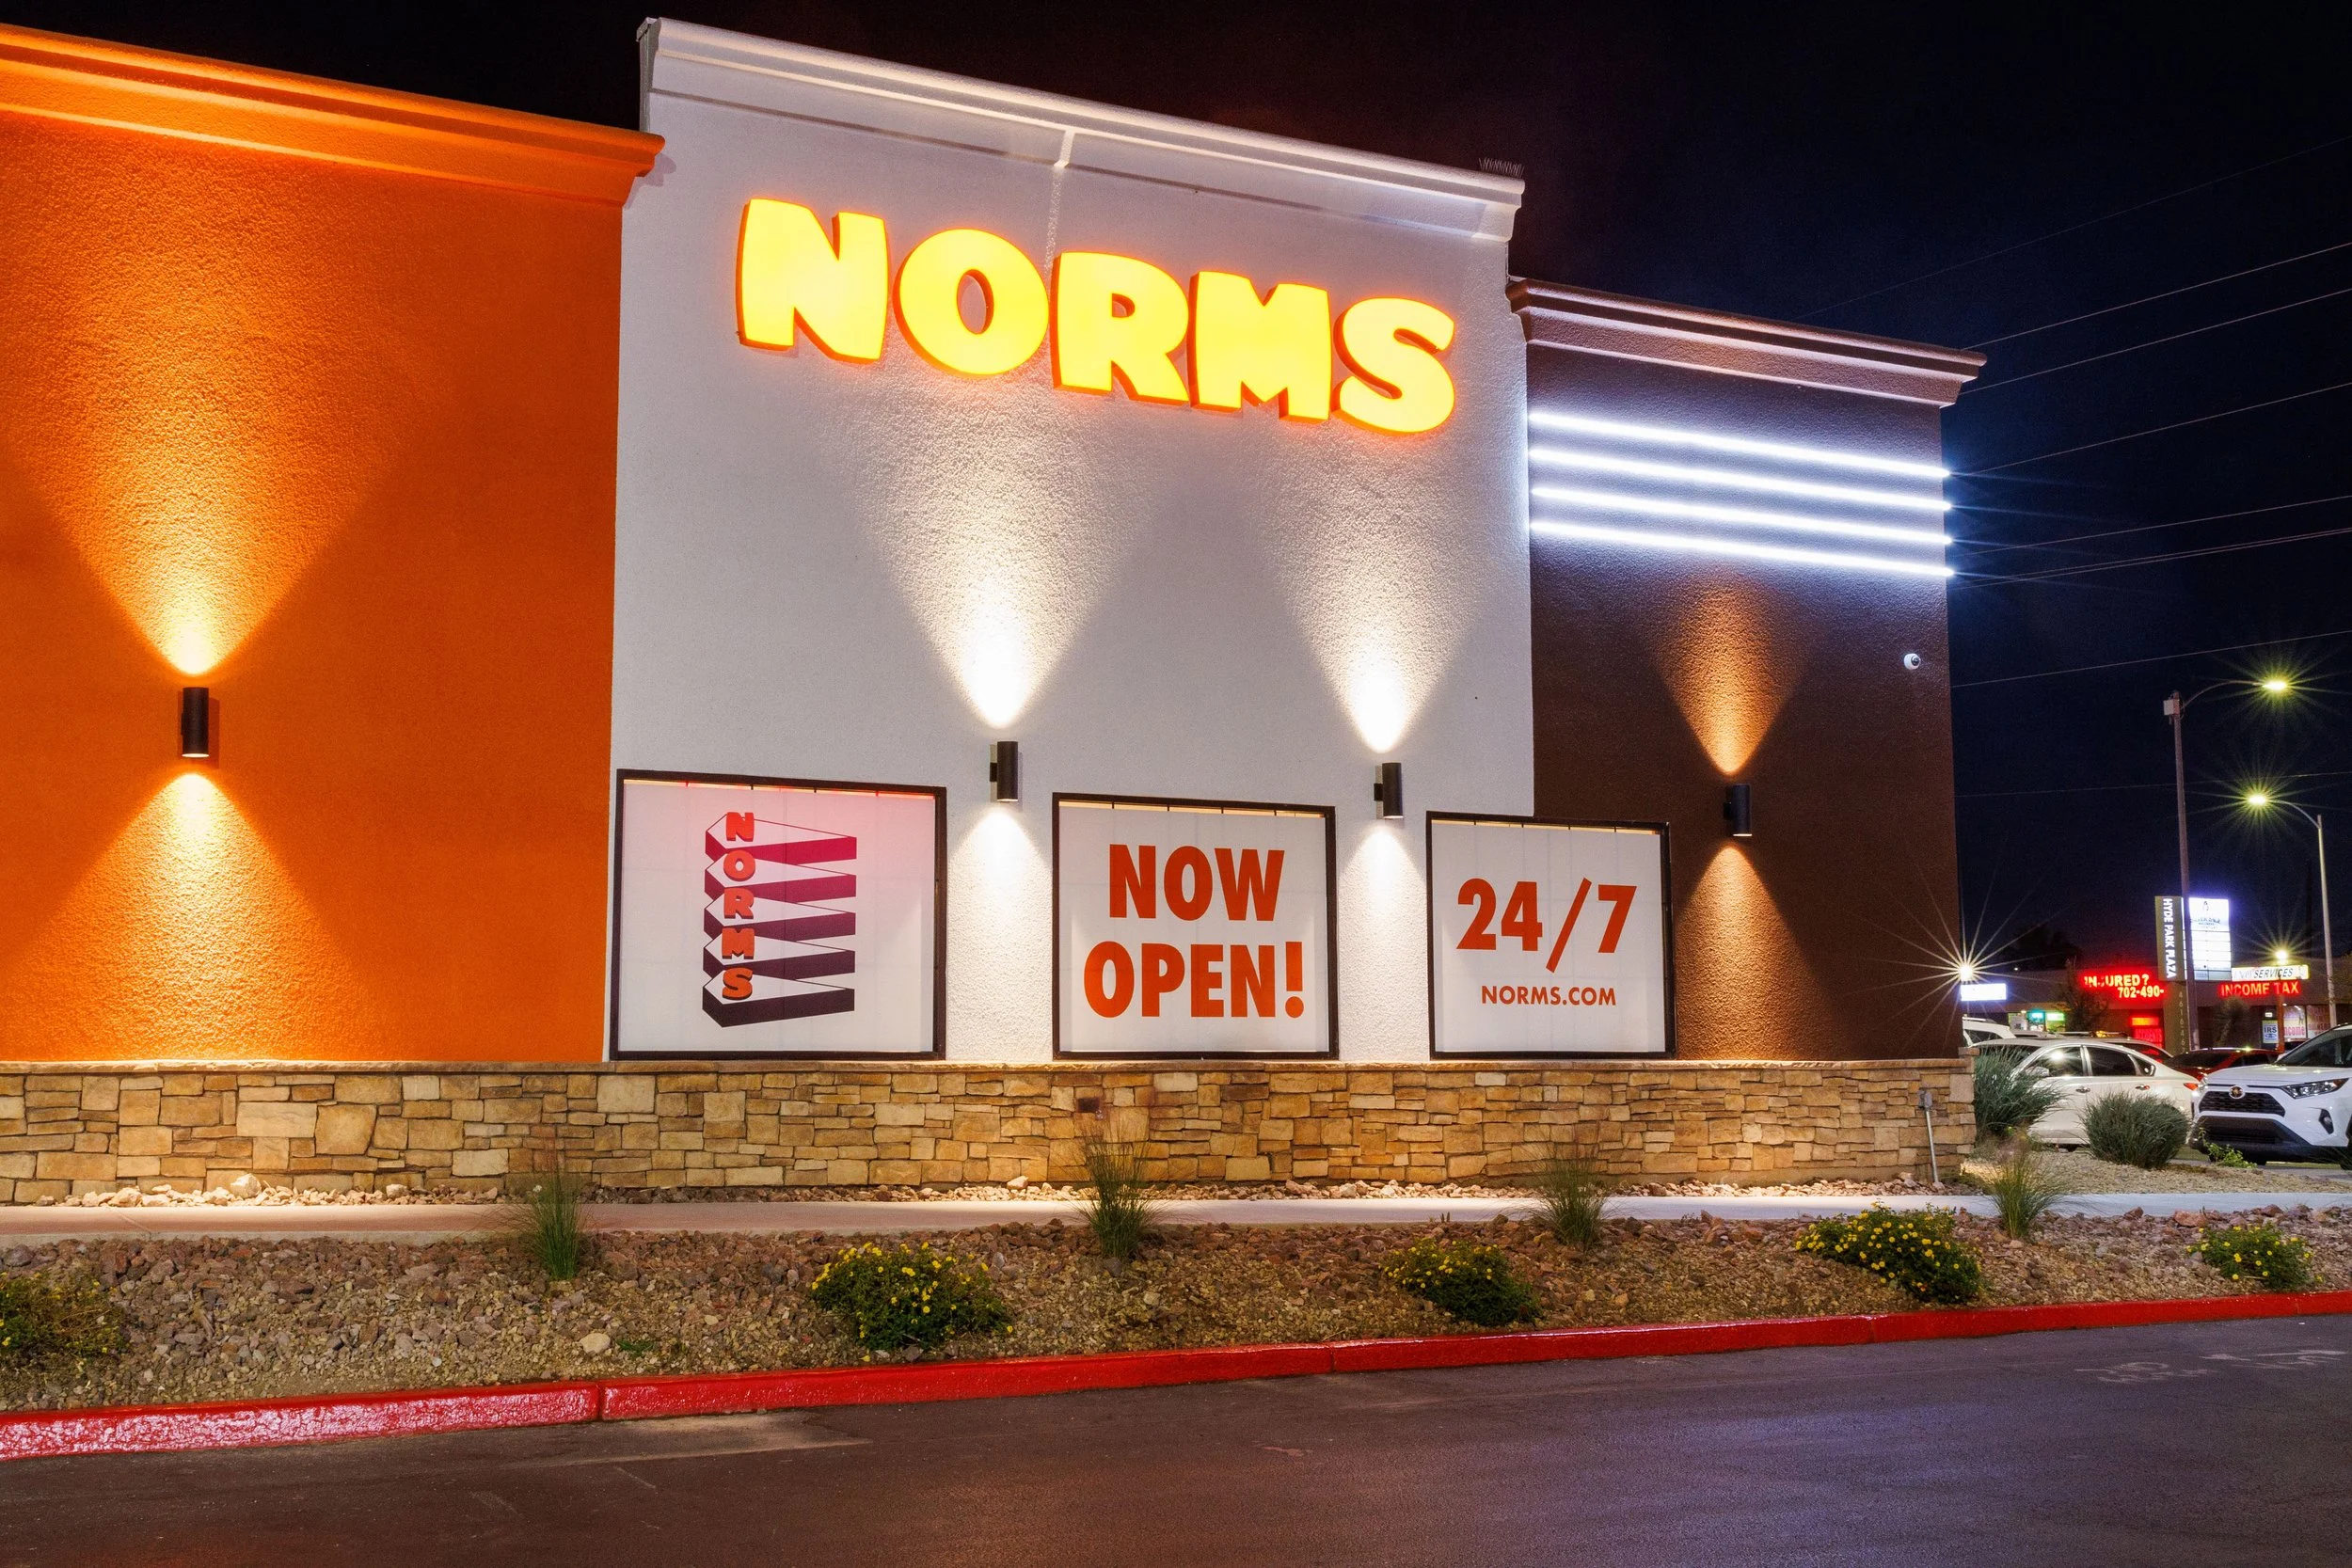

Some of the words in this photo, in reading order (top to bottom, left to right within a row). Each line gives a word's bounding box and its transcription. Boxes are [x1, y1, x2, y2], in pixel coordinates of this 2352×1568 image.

[738, 198, 1455, 434] NORMS
[1109, 844, 1285, 921] NOW
[722, 812, 756, 1000] NORMS
[2163, 898, 2174, 923] HYDE
[1455, 878, 1637, 974] 24/7
[2164, 925, 2175, 948] PARK
[2165, 949, 2177, 978] PLAZA
[2253, 968, 2294, 979] SERVICES
[1084, 941, 1305, 1018] OPEN!
[2220, 982, 2270, 997] INCOME
[2273, 980, 2299, 994] TAX
[1481, 985, 1616, 1006] NORMS.COM
